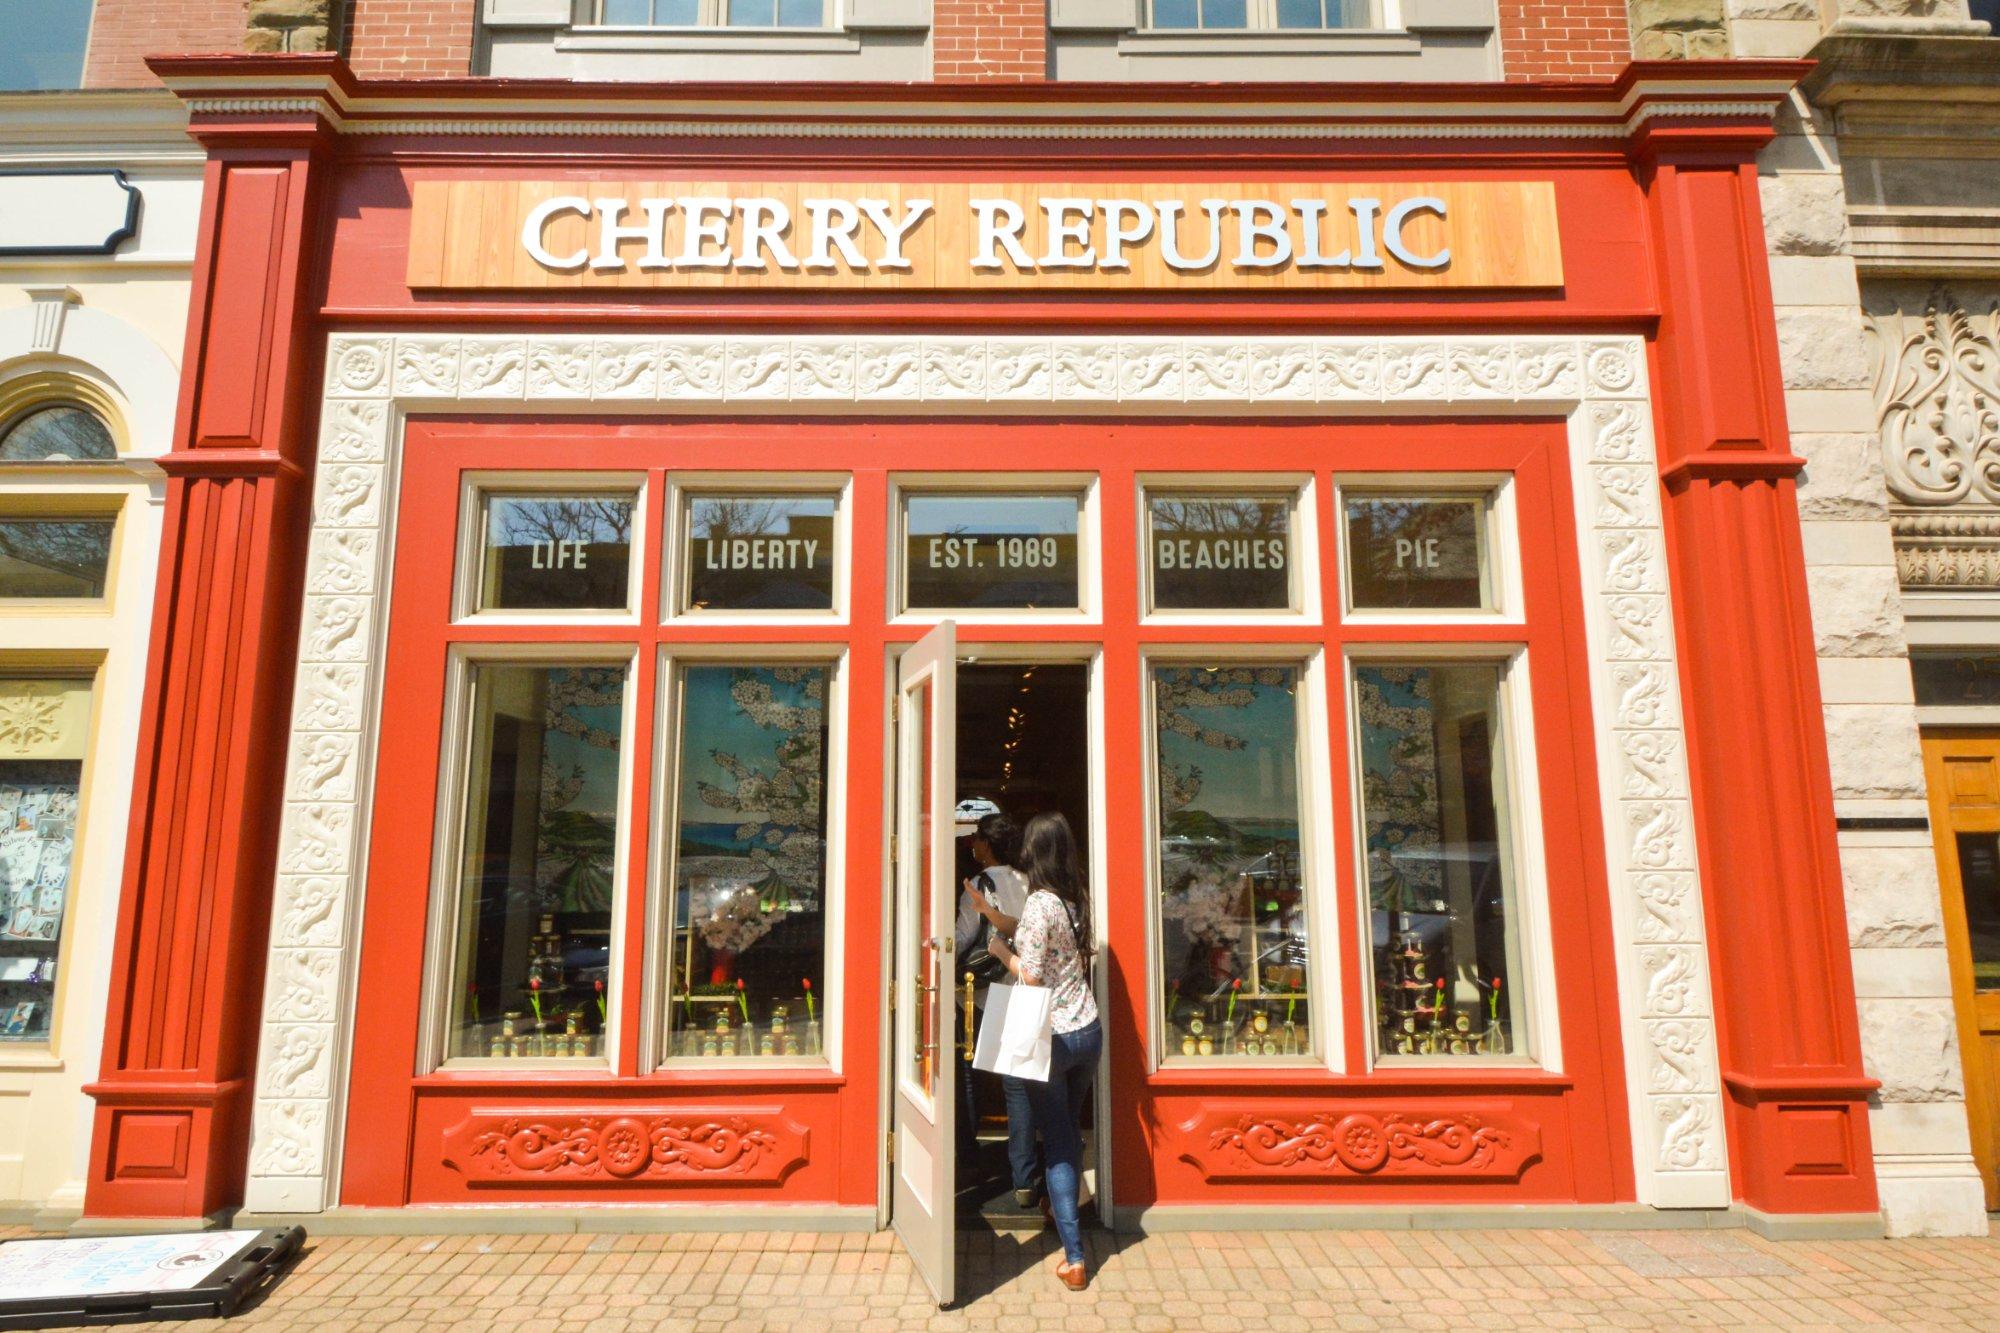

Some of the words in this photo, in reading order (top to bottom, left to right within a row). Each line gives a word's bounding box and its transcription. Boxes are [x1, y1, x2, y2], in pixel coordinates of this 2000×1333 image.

[522, 198, 933, 268] CHERRY
[969, 197, 1452, 271] REPUBLIC
[531, 539, 588, 570] LIFE
[705, 540, 818, 569] LIBERTY
[929, 538, 984, 568] EST.
[996, 538, 1057, 568] 1989
[1158, 539, 1285, 570] BEACHES
[1396, 538, 1440, 569] PIE
